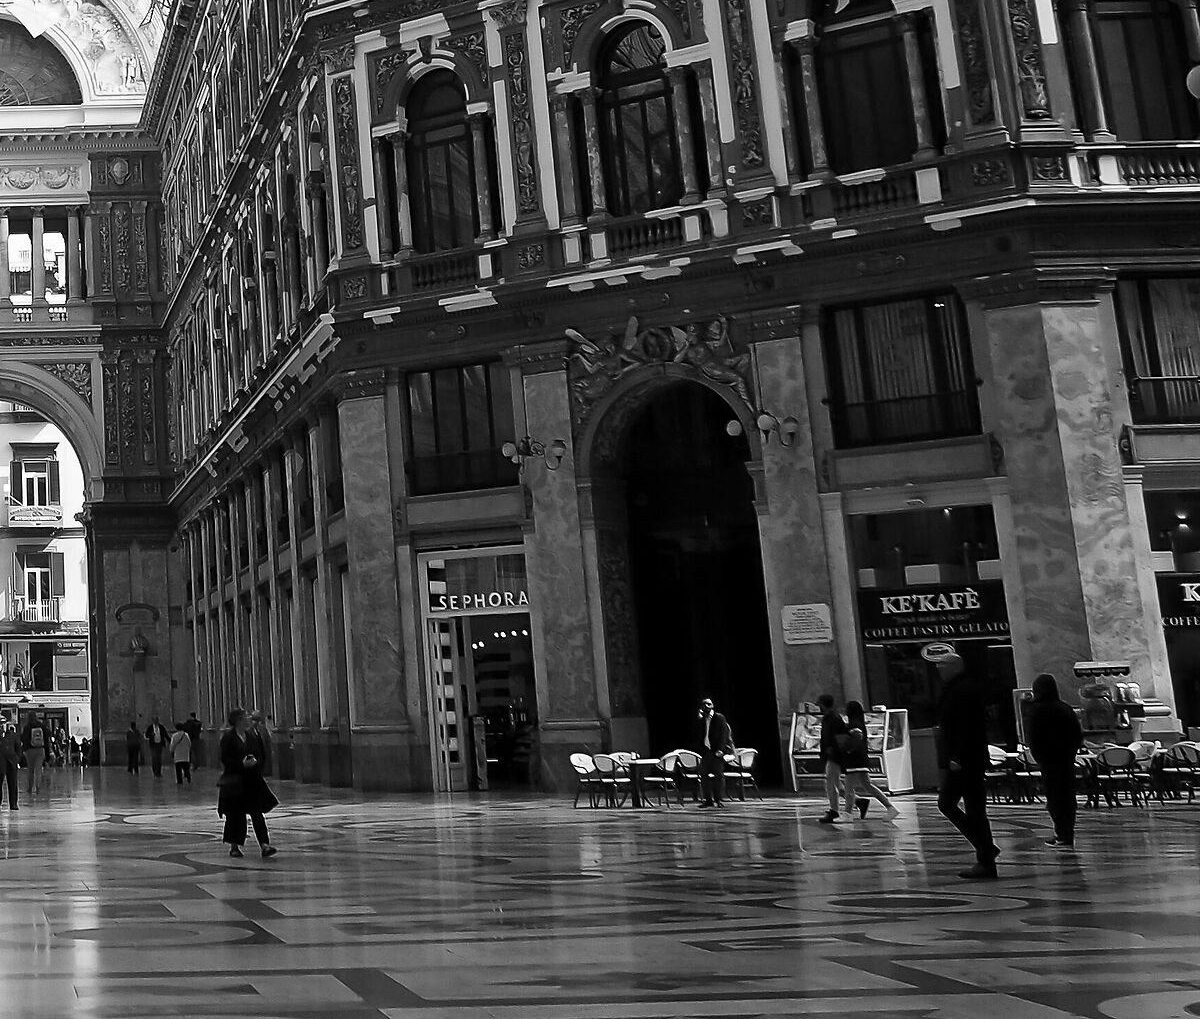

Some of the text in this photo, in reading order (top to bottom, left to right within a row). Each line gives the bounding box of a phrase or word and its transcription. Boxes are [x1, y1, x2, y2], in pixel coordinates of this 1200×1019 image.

[439, 590, 529, 610] SEPHORA
[864, 621, 1009, 638] COFFEE PASTRY GELATO
